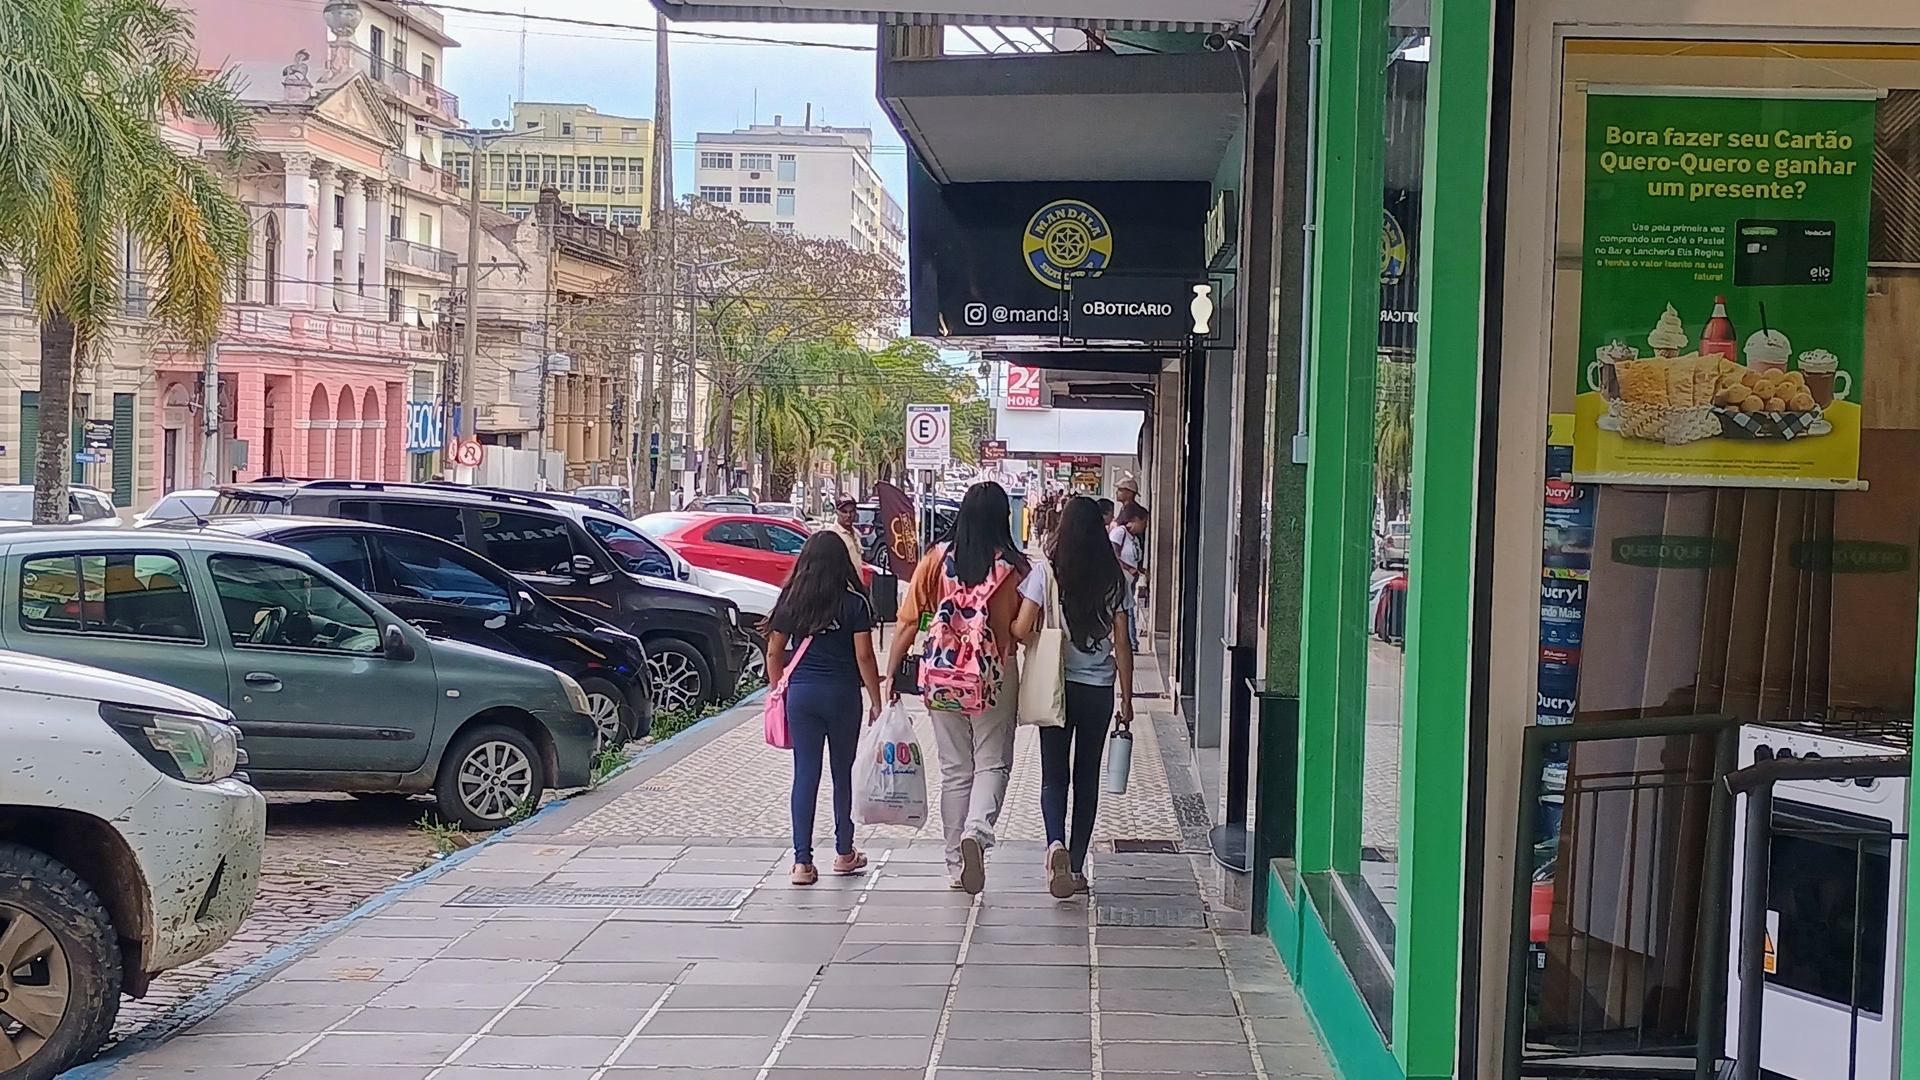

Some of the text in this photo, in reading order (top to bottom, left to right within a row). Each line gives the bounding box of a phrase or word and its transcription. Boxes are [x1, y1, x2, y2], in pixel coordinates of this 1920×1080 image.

[1606, 126, 1853, 150] Bora fazer seu Cartão
[1600, 151, 1857, 178] Quero-Quero e ganhar
[1648, 180, 1807, 202] um presente?
[1035, 208, 1101, 237] MANDALA
[1632, 223, 1726, 234] Use pela primeira vez
[1599, 235, 1650, 244] comprando
[1666, 235, 1688, 245] Café
[1697, 236, 1725, 246] Pastel
[1594, 247, 1607, 255] no
[1608, 246, 1623, 255] Bar
[1633, 246, 1675, 256] Lancheria
[1677, 247, 1693, 257] Elis
[1694, 248, 1725, 259] Regina
[1631, 260, 1639, 268] o
[1640, 260, 1663, 268] valor
[919, 420, 930, 438] E
[1559, 607, 1582, 619] Mais
